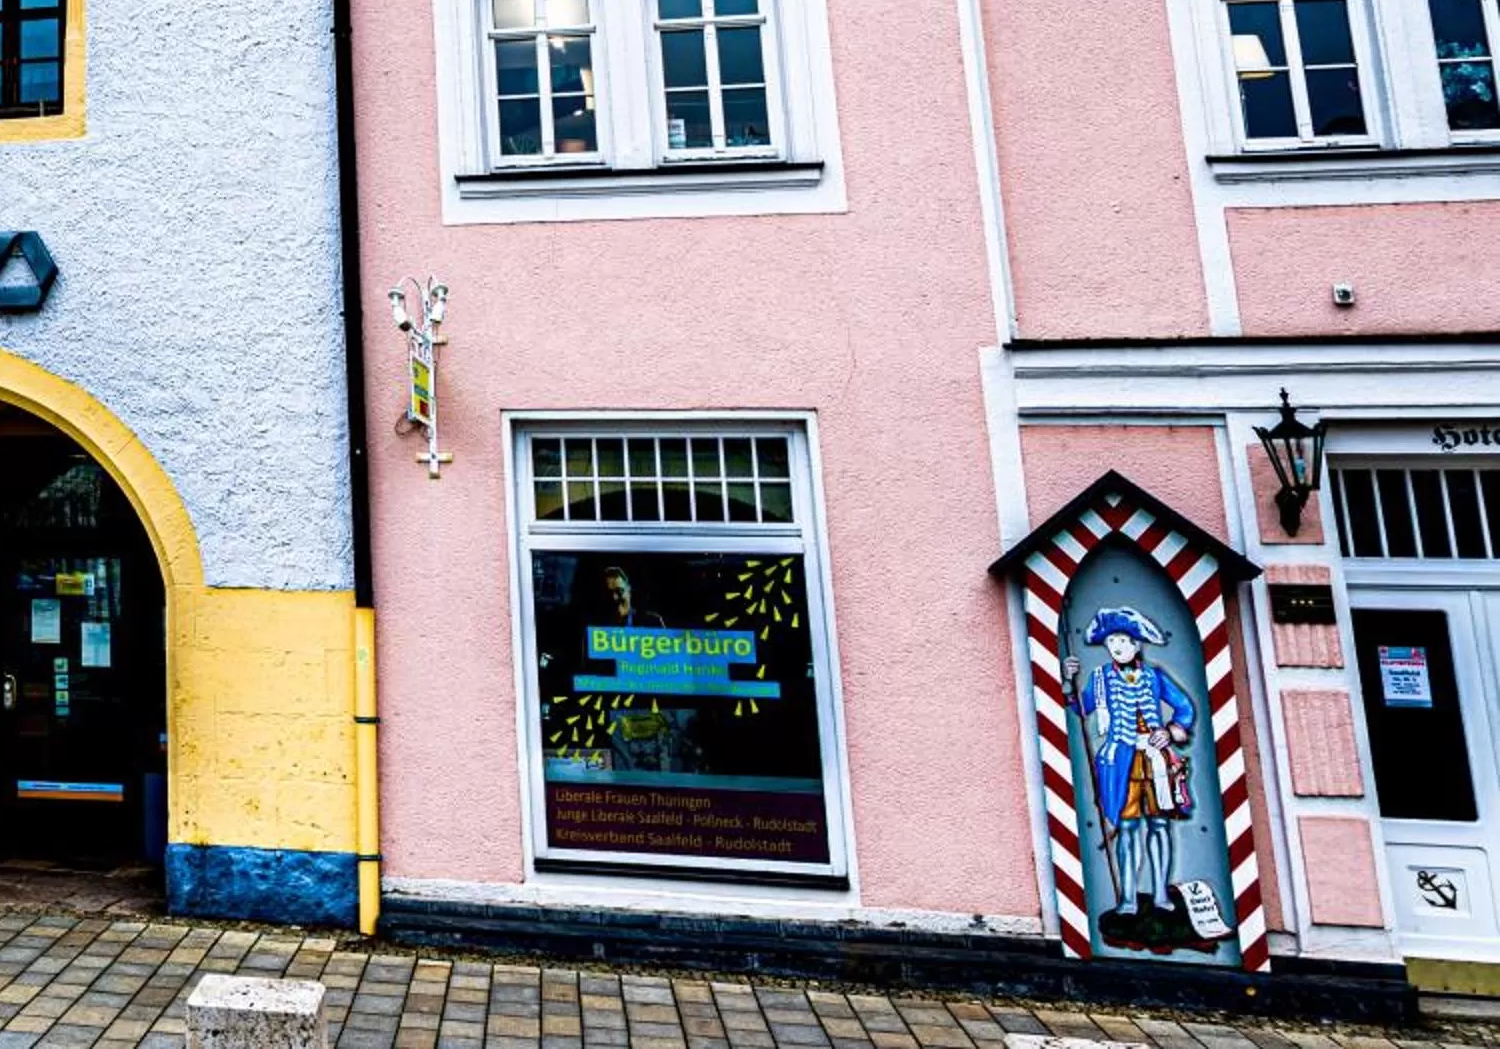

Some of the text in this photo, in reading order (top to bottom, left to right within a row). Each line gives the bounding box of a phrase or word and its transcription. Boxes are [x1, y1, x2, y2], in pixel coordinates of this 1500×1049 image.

[592, 629, 751, 658] Bürgerbüro
[555, 789, 603, 803] Liberale
[605, 791, 647, 806] Frauen
